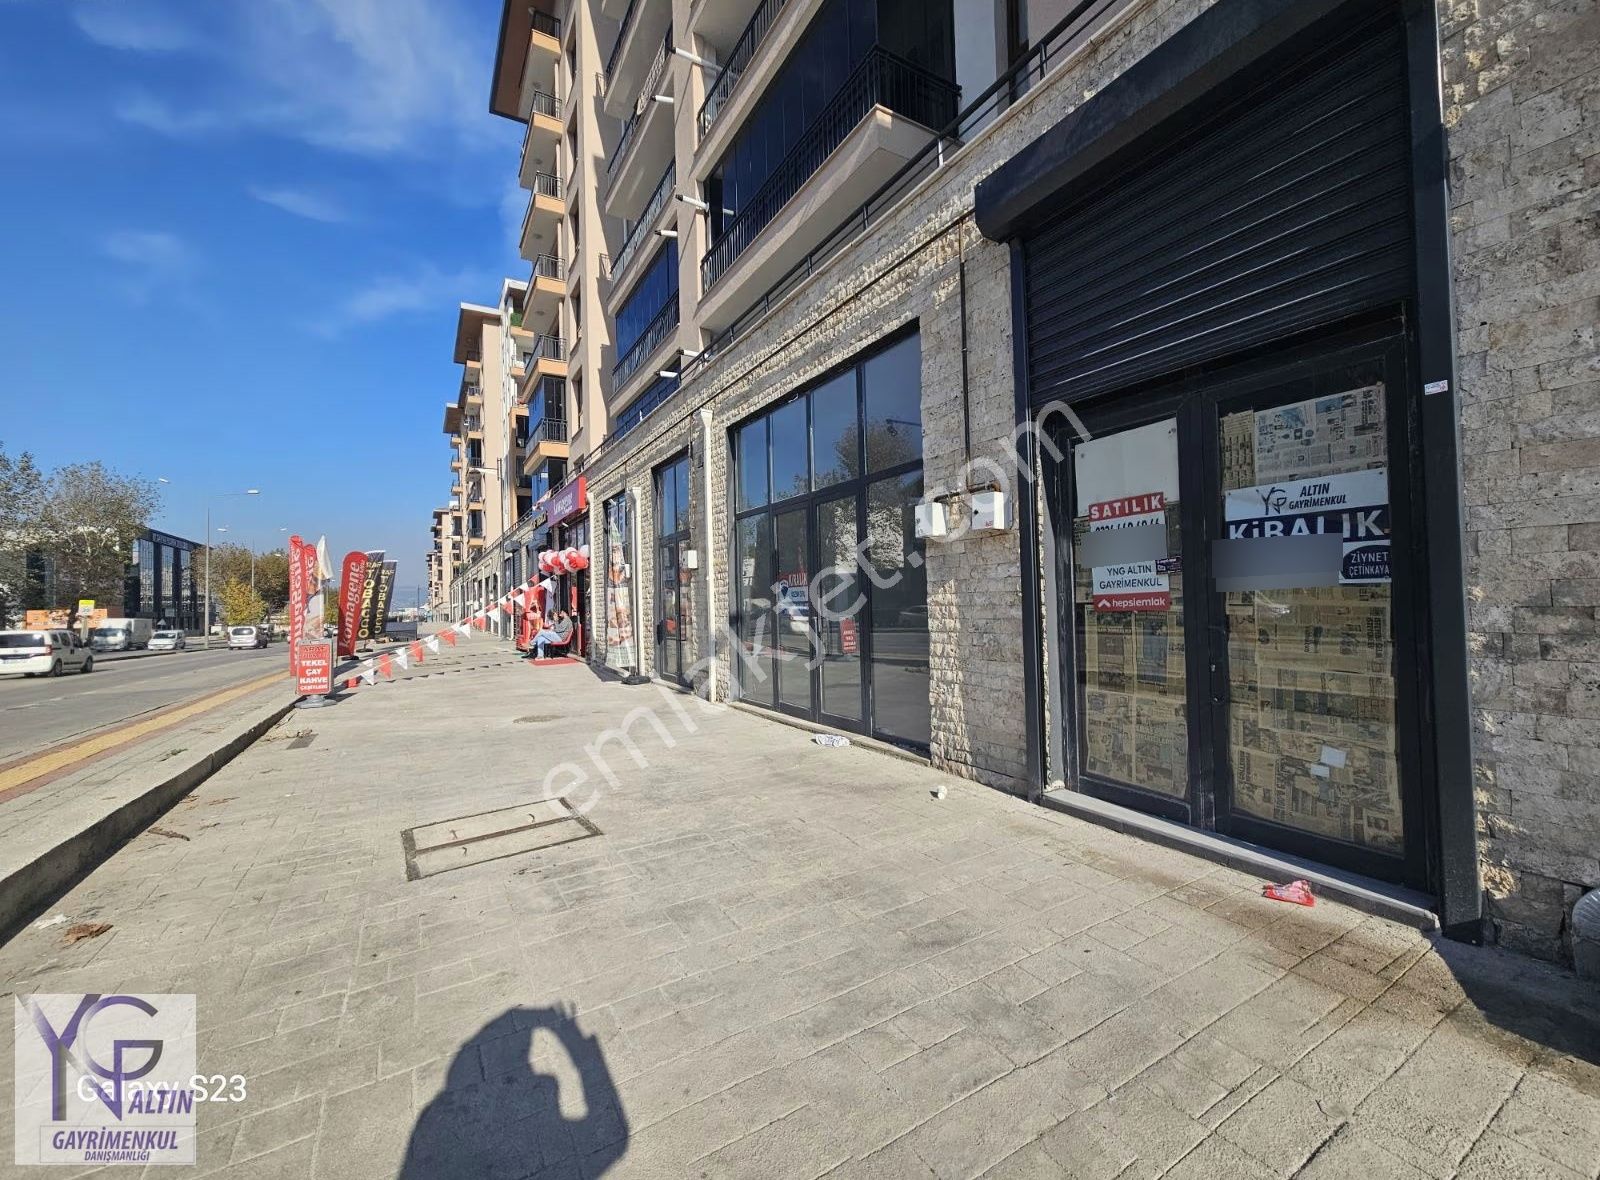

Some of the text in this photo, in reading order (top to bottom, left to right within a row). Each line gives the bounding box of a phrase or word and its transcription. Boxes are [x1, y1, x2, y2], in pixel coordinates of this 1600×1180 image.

[1300, 483, 1330, 498] ALTIN
[1090, 494, 1162, 520] SATILIK
[1351, 550, 1389, 563] ZİYNET
[1107, 566, 1126, 576] YNG
[1127, 564, 1152, 576] ALTIN
[1099, 577, 1163, 590] GAYRİMENKUL
[358, 569, 376, 638] TOBACCO
[301, 659, 328, 667] TEKEL
[305, 668, 323, 677] ÇAY
[300, 676, 328, 684] KAHVE
